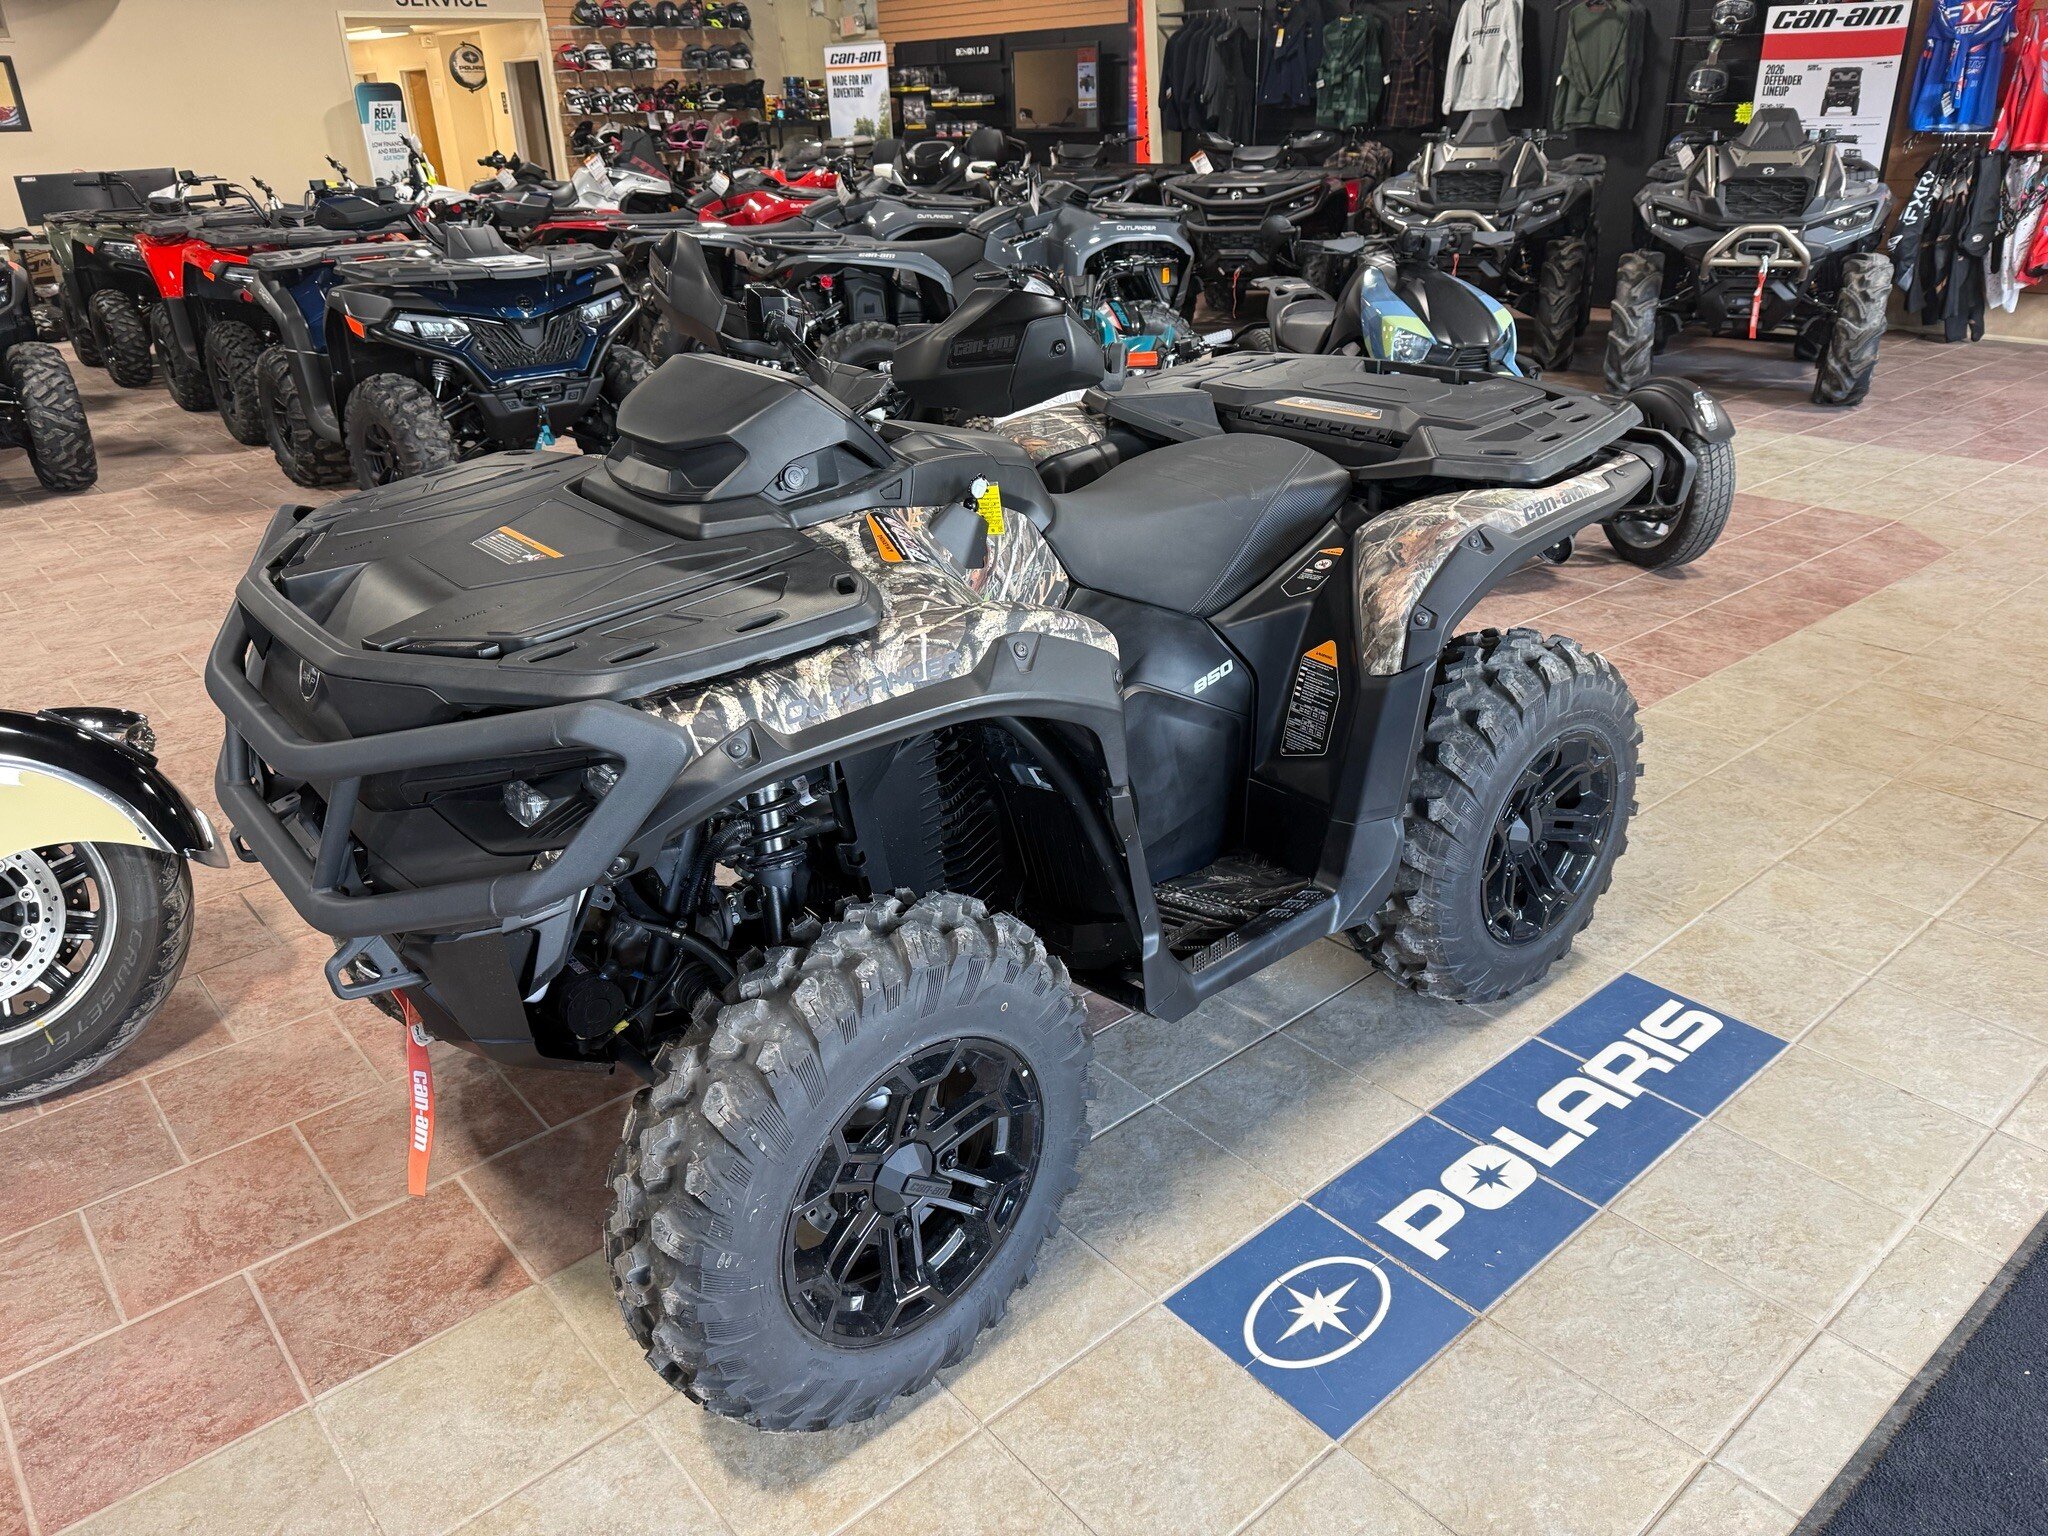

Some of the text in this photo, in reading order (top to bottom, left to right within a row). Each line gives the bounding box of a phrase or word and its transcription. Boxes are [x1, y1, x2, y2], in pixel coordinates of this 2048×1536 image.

[1772, 4, 1904, 29] can-am
[830, 50, 882, 65] can-am
[1765, 64, 1785, 75] 2026
[832, 74, 873, 87] MADE FOR ANY
[1763, 75, 1803, 86] DEFENDER
[833, 87, 865, 98] ADVENTURE
[1762, 86, 1790, 97] LINEUP
[374, 107, 393, 119] REV
[374, 119, 396, 132] RIDE
[954, 335, 1016, 356] can-am
[1193, 659, 1234, 695] 850
[413, 1070, 429, 1153] can-am
[1376, 998, 1724, 1261] POLARIS
